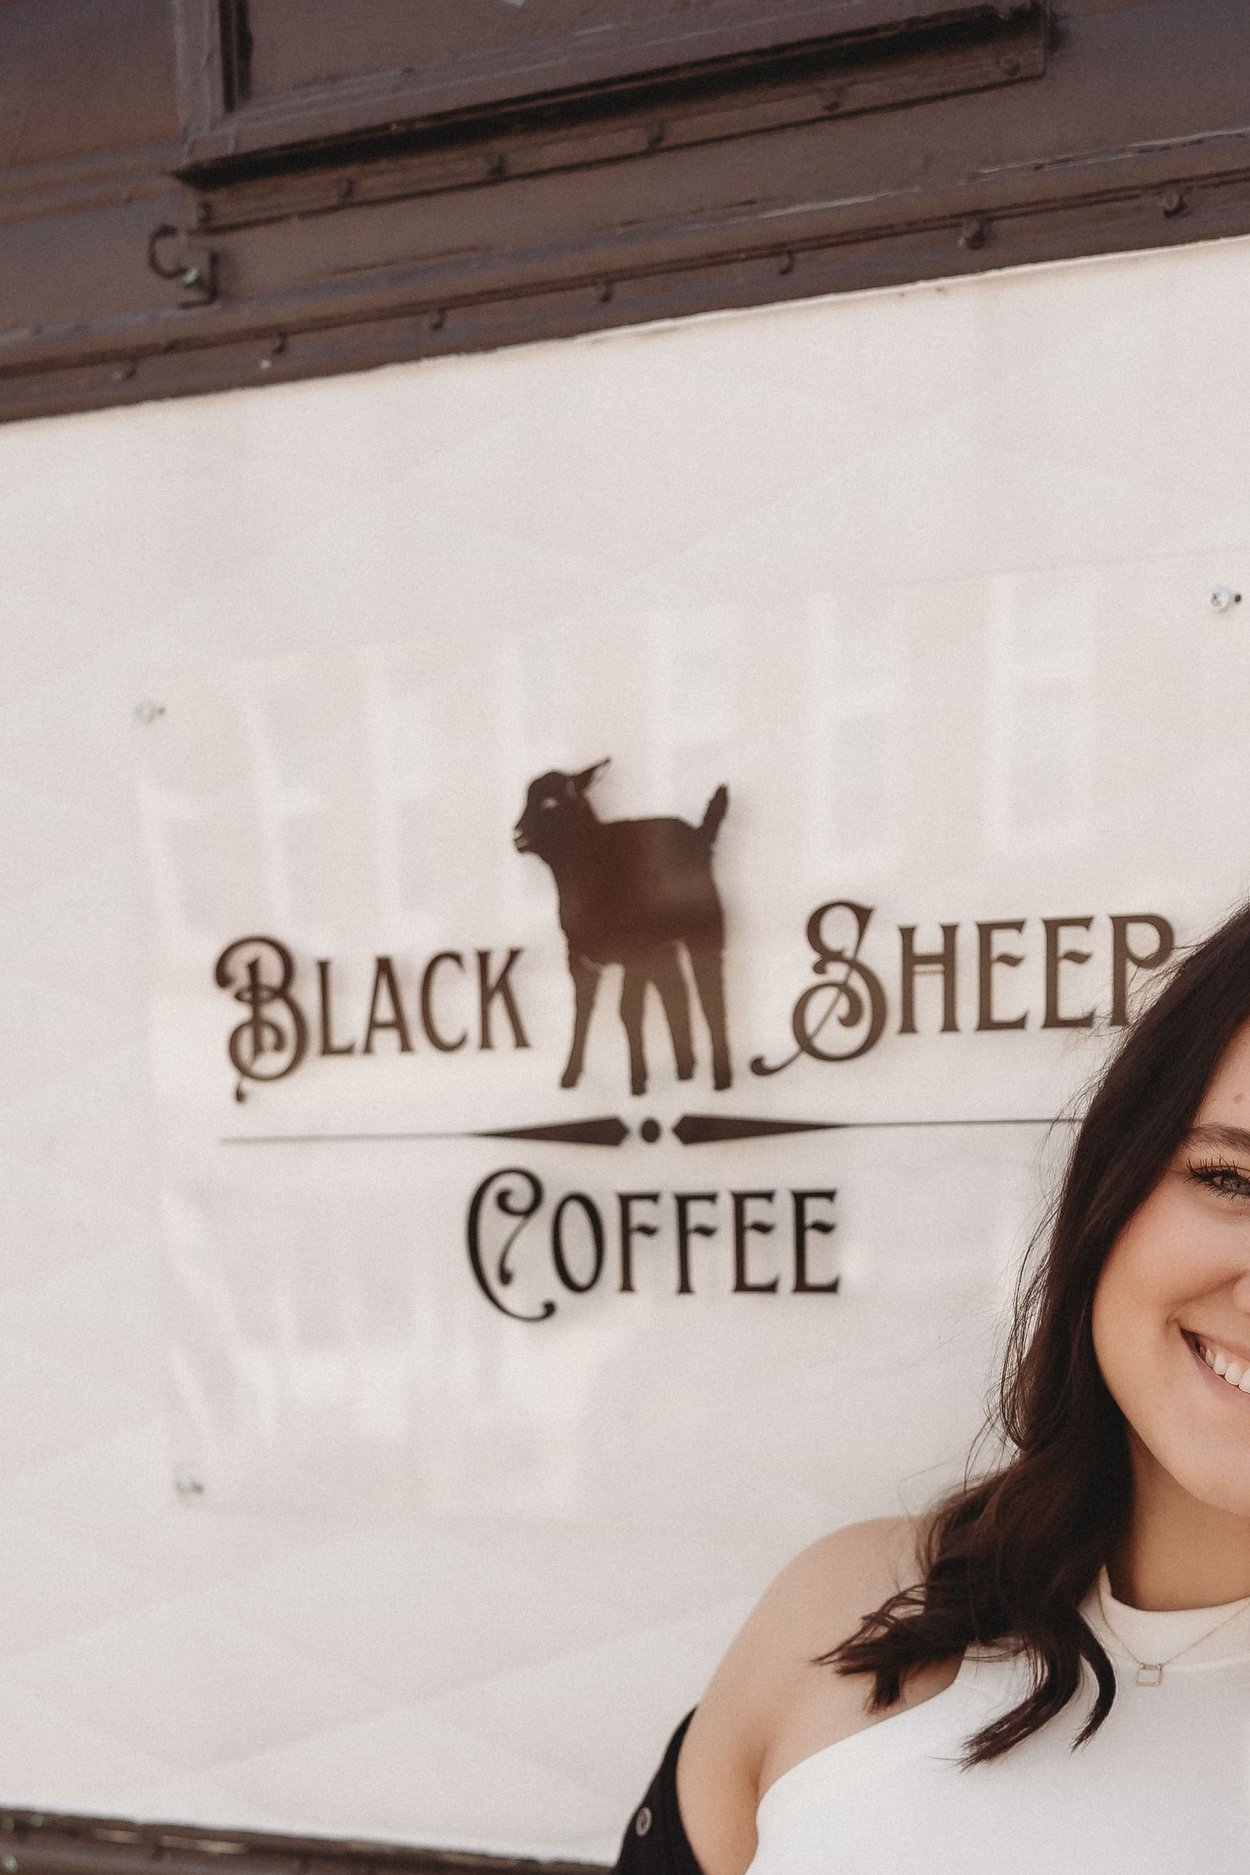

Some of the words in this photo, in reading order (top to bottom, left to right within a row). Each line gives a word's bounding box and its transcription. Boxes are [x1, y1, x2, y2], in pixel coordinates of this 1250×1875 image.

[213, 935, 531, 1103] BLACK
[748, 899, 1174, 1078] SHEEP
[465, 1166, 841, 1324] COFFEE
